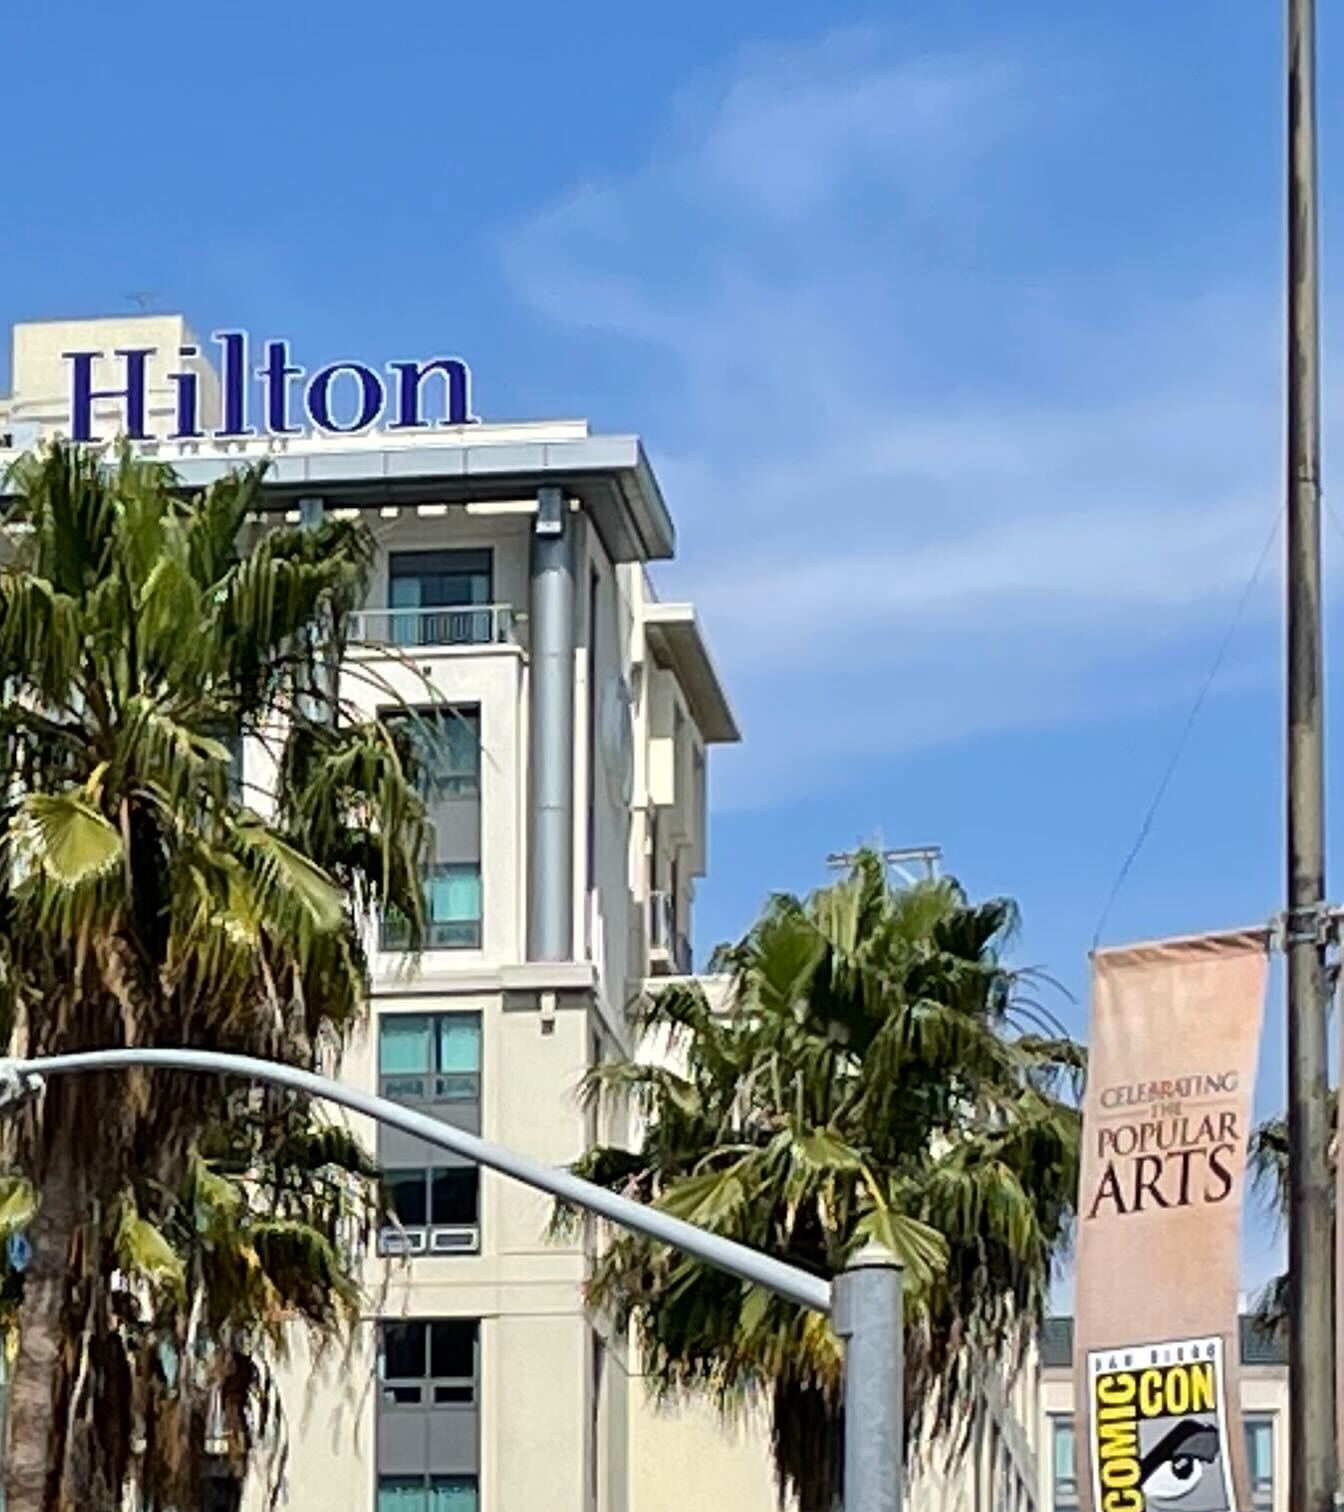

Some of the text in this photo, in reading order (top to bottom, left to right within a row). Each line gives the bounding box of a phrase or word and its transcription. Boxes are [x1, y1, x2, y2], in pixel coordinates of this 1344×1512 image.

[61, 331, 479, 443] Hilton
[1100, 1071, 1239, 1109] CELEBRATING
[1151, 1101, 1182, 1118] THE
[1097, 1112, 1241, 1158] POPULAR
[1087, 1144, 1235, 1219] ARTS
[1139, 1362, 1217, 1418] CON
